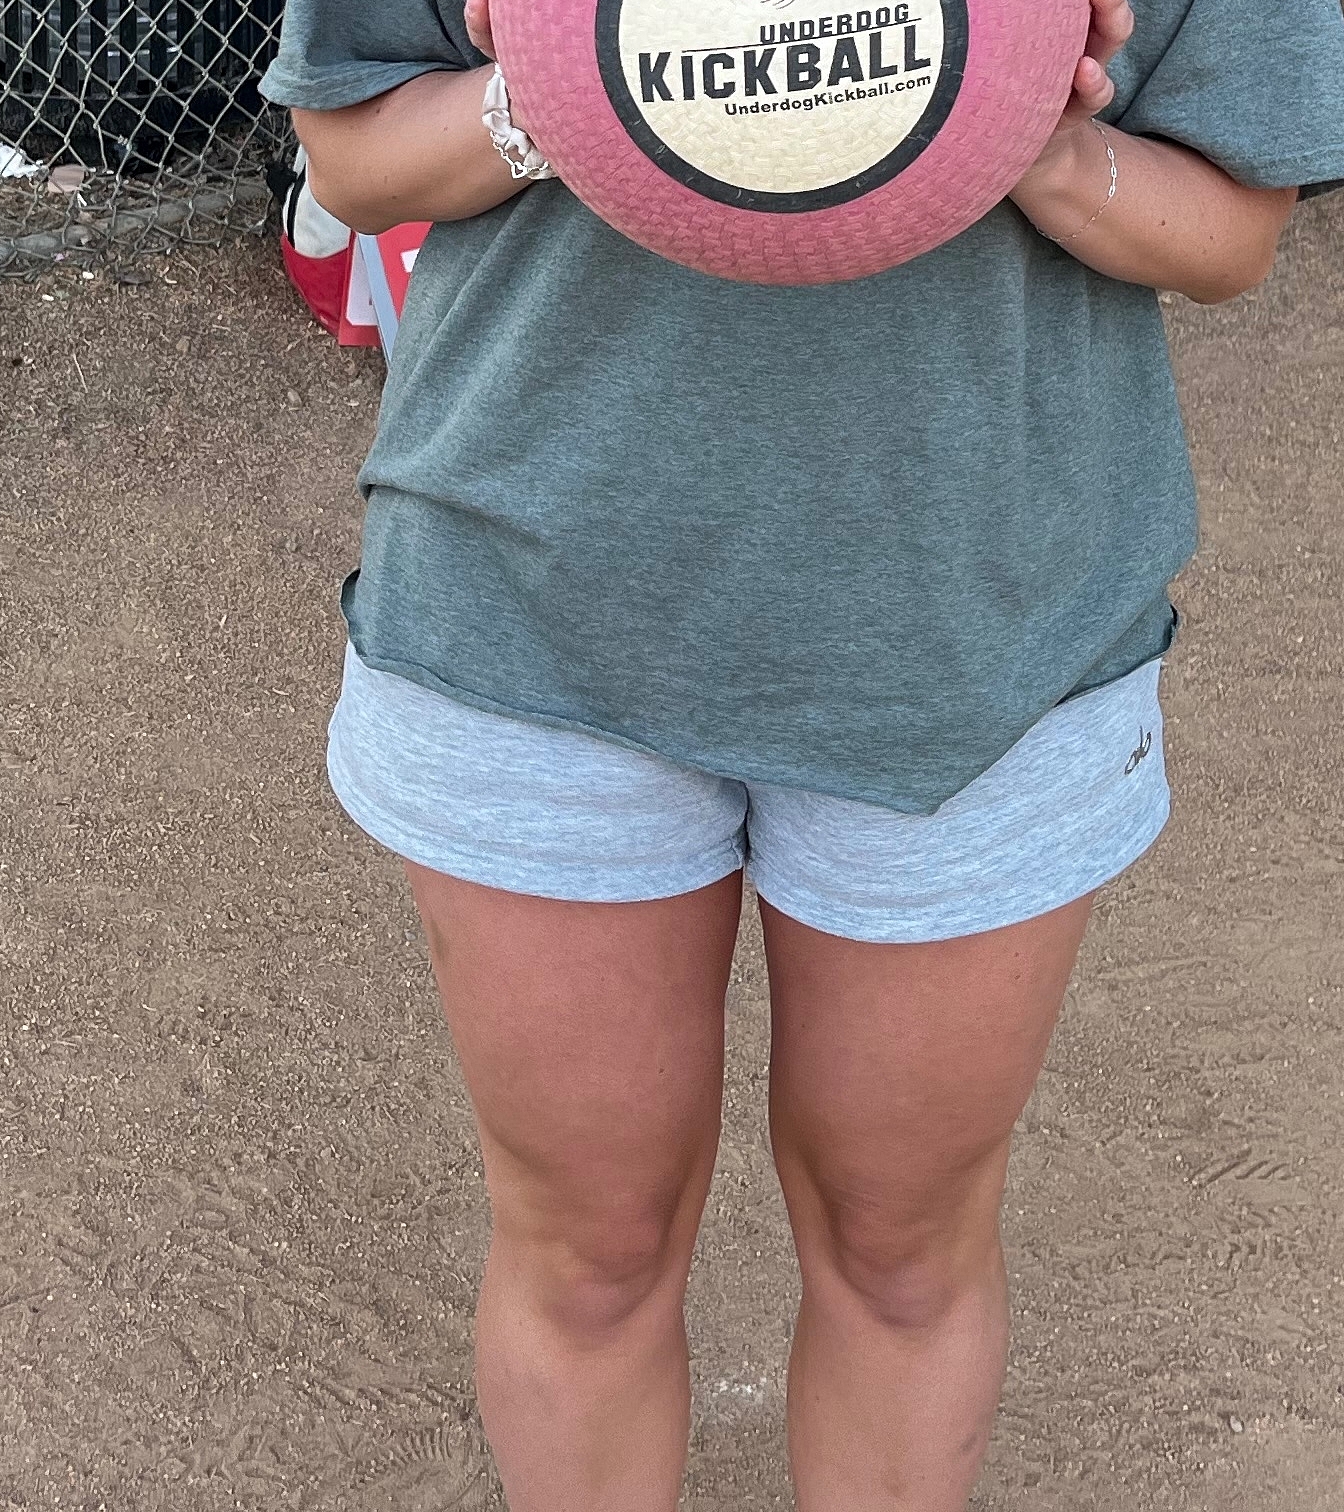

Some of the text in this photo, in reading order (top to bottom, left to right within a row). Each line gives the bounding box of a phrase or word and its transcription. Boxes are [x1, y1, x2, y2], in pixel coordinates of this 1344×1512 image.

[760, 3, 909, 44] UNDERDOG
[638, 25, 931, 103] KICKBALL
[724, 75, 931, 116] UnderdogKickball.com
